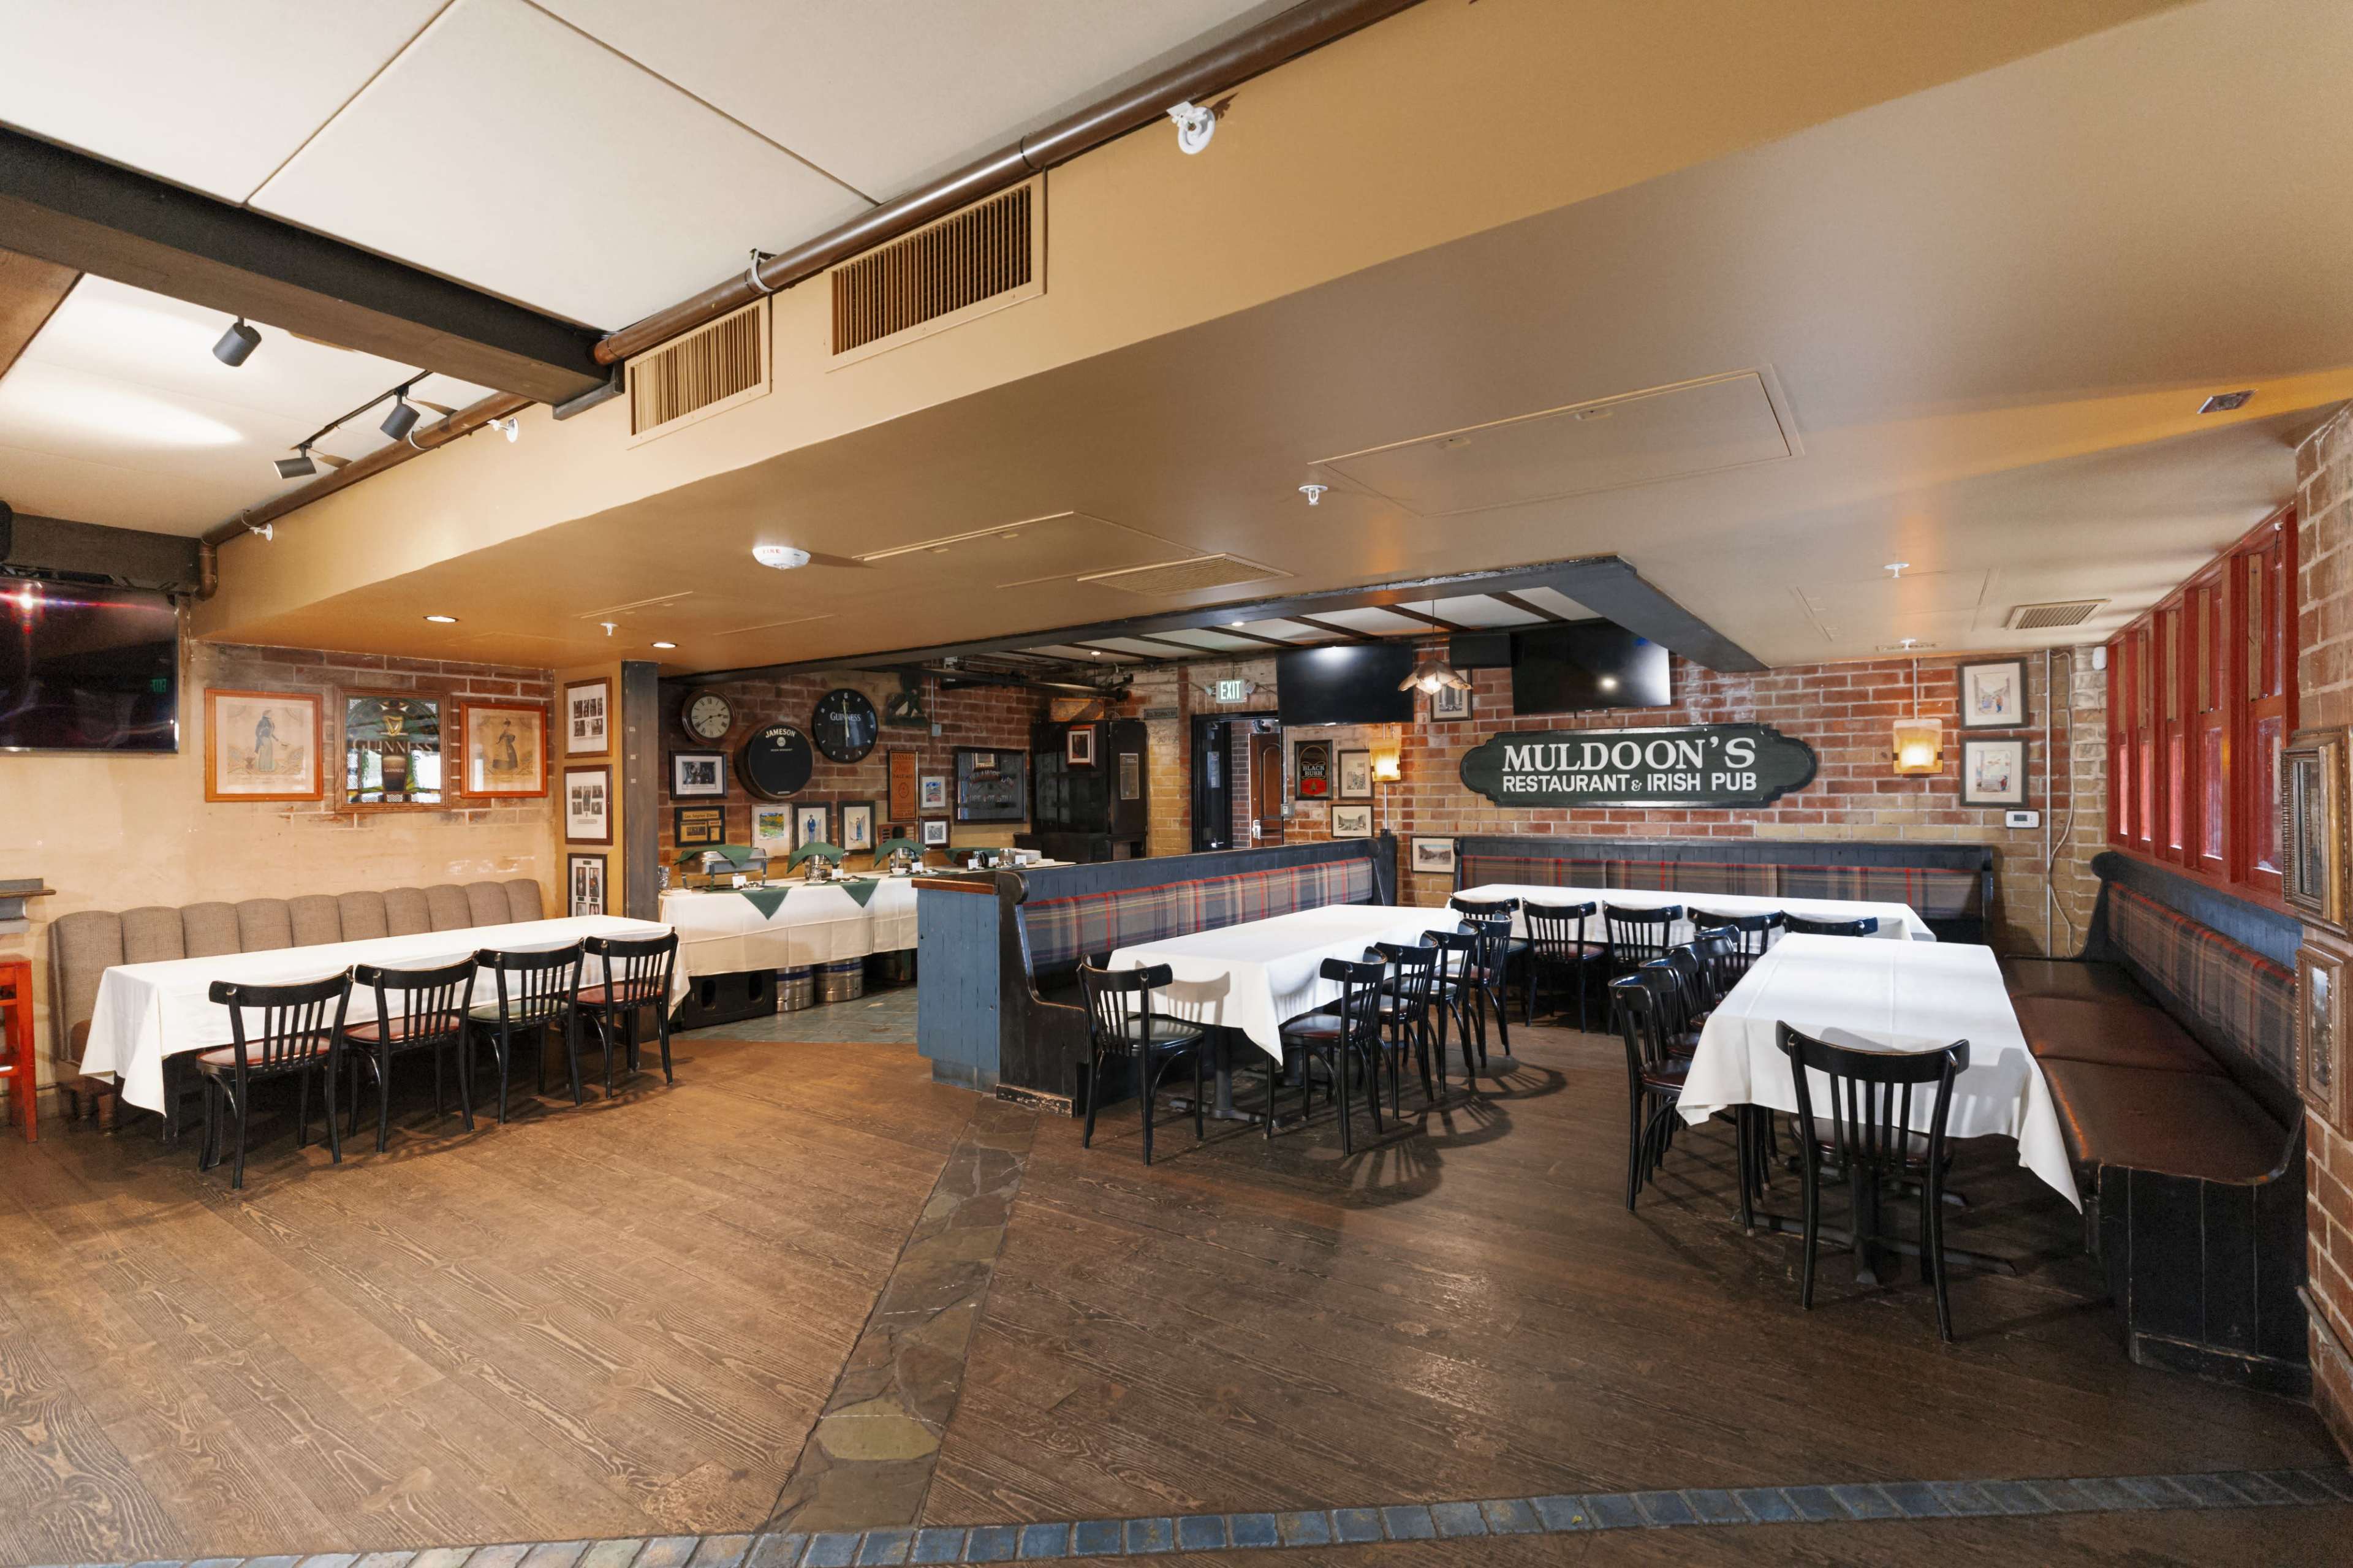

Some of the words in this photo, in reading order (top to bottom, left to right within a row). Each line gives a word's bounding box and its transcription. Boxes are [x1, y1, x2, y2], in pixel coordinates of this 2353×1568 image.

[1220, 681, 1240, 699] EXIT
[830, 711, 861, 721] GUINNESS
[765, 728, 795, 738] JAMESON
[353, 740, 433, 754] GUINNESS
[1502, 736, 1756, 772] MULDOON'S
[1502, 774, 1630, 793] RESTAURANT
[1631, 779, 1642, 791] &
[1647, 773, 1700, 792] IRISH
[1711, 772, 1757, 791] PUB
